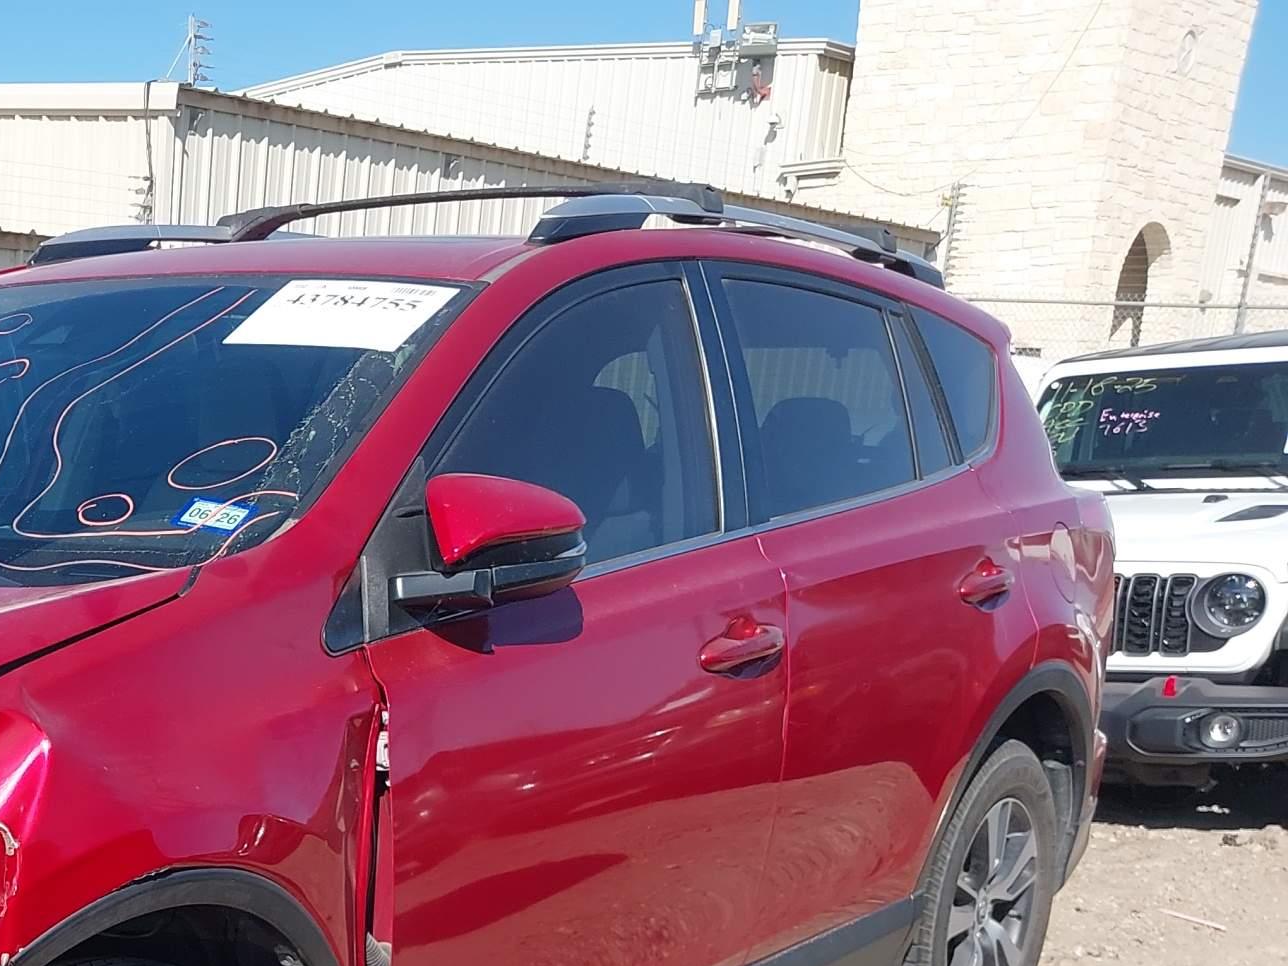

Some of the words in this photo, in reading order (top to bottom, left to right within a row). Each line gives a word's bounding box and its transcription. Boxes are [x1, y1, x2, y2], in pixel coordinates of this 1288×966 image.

[287, 294, 423, 311] 43784755
[188, 507, 212, 520] 06
[215, 512, 241, 525] 26
